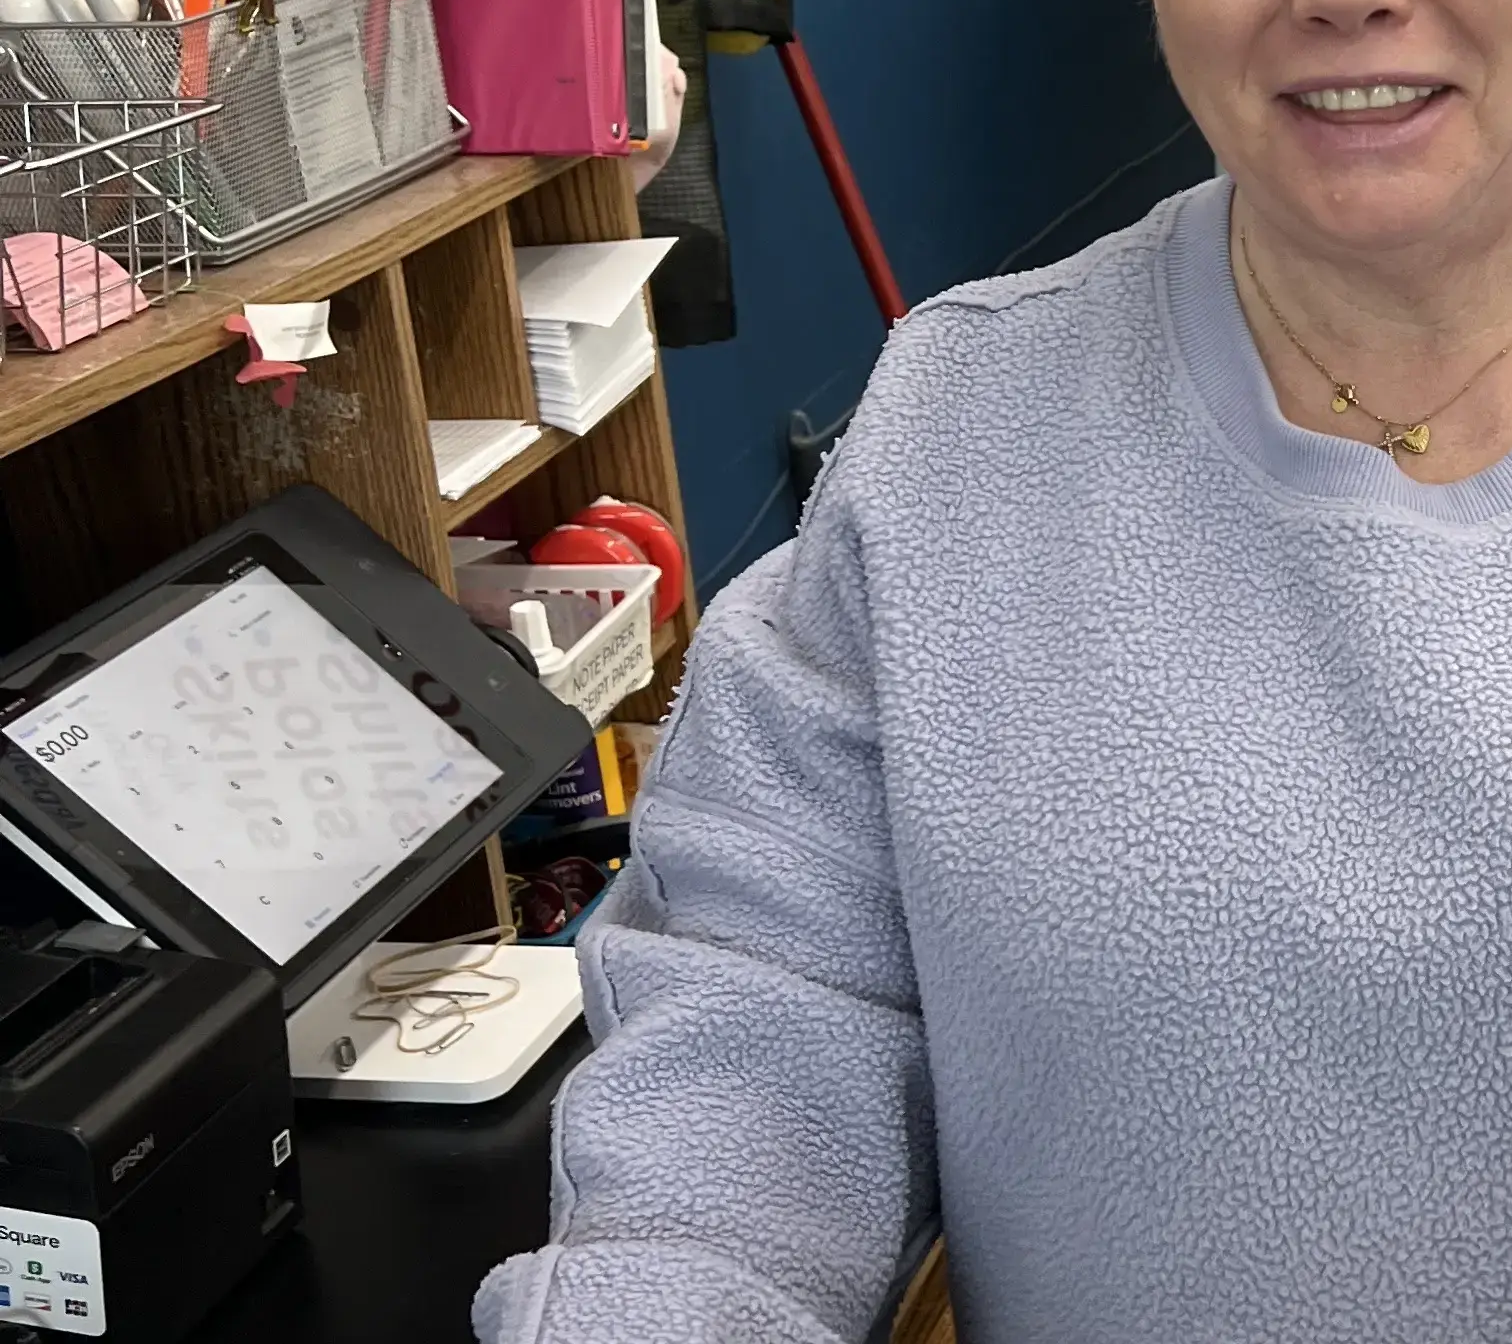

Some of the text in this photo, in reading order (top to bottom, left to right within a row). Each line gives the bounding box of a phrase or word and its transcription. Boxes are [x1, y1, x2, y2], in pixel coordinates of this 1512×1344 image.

[572, 661, 601, 696] NOTE
[602, 622, 635, 668] PAPER
[612, 643, 644, 688] PAPER
[35, 724, 89, 763] $0.00
[549, 782, 578, 795] Lint
[0, 1224, 61, 1249] Square
[58, 1270, 89, 1285] VISA
